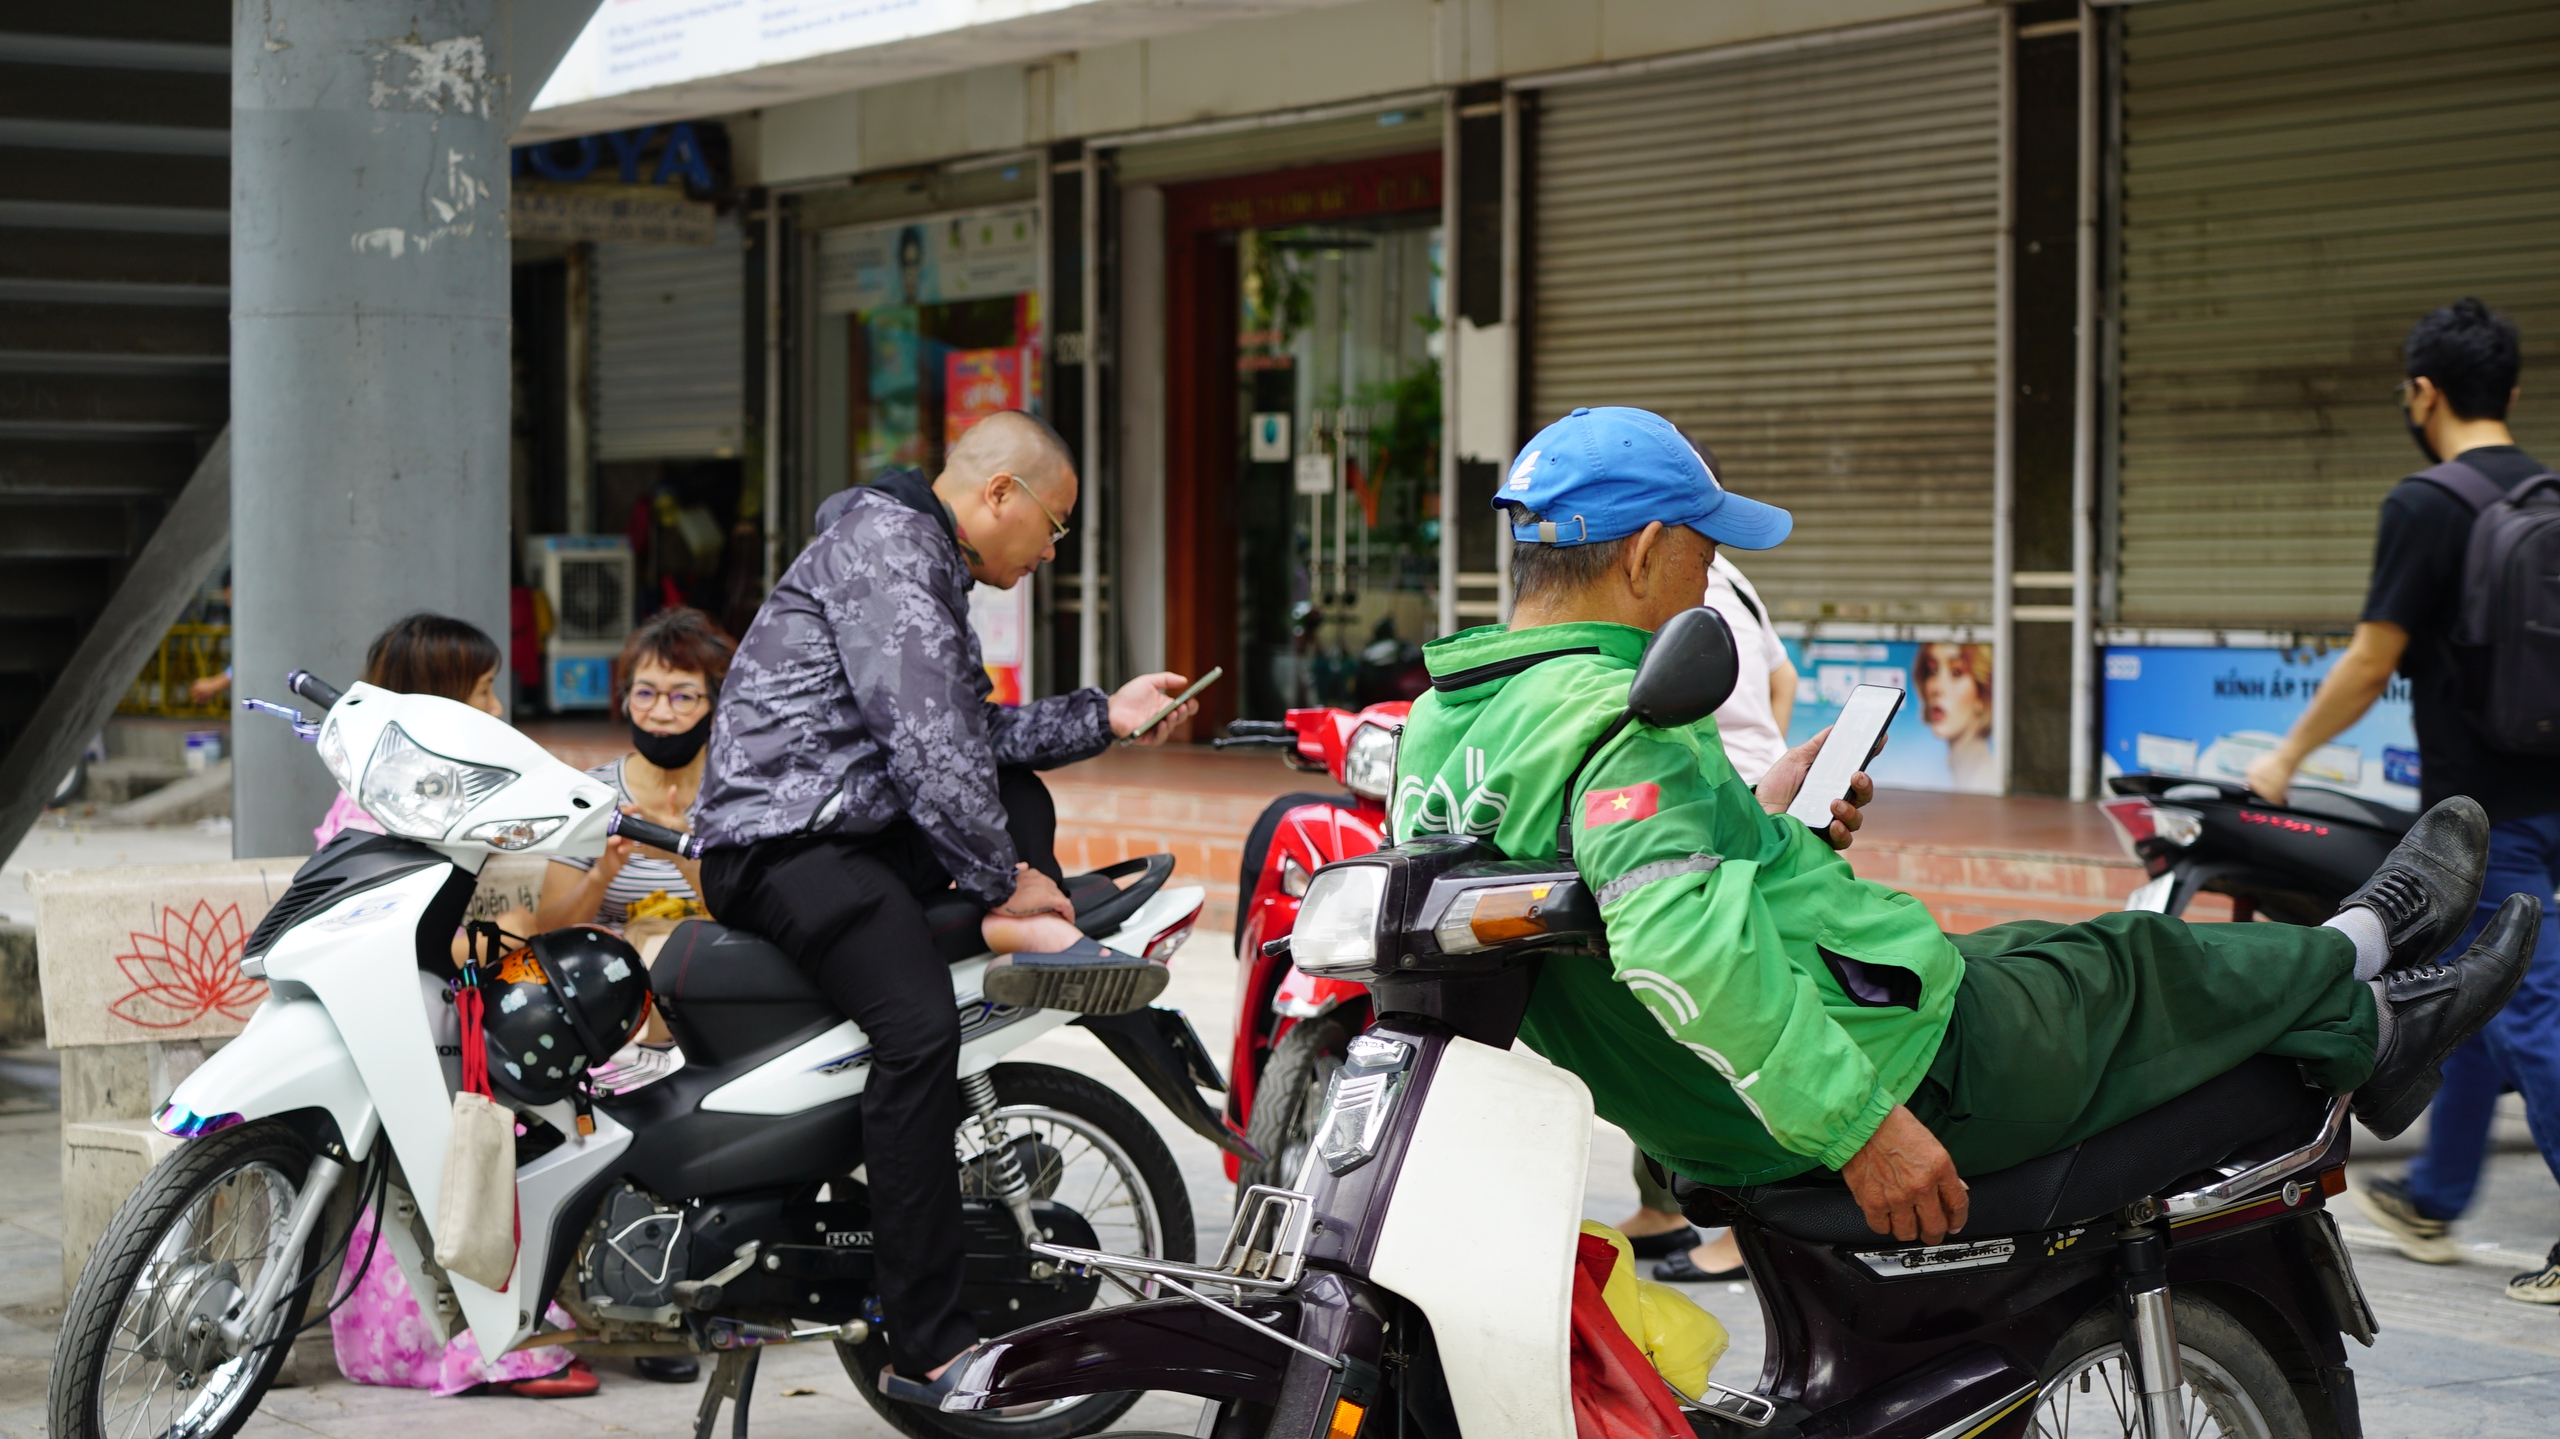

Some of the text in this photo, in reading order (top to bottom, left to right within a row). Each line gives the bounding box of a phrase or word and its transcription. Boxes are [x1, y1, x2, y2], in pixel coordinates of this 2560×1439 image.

[512, 124, 713, 189] OYA
[435, 1044, 463, 1057] ON
[1350, 1039, 1385, 1051] HONDA
